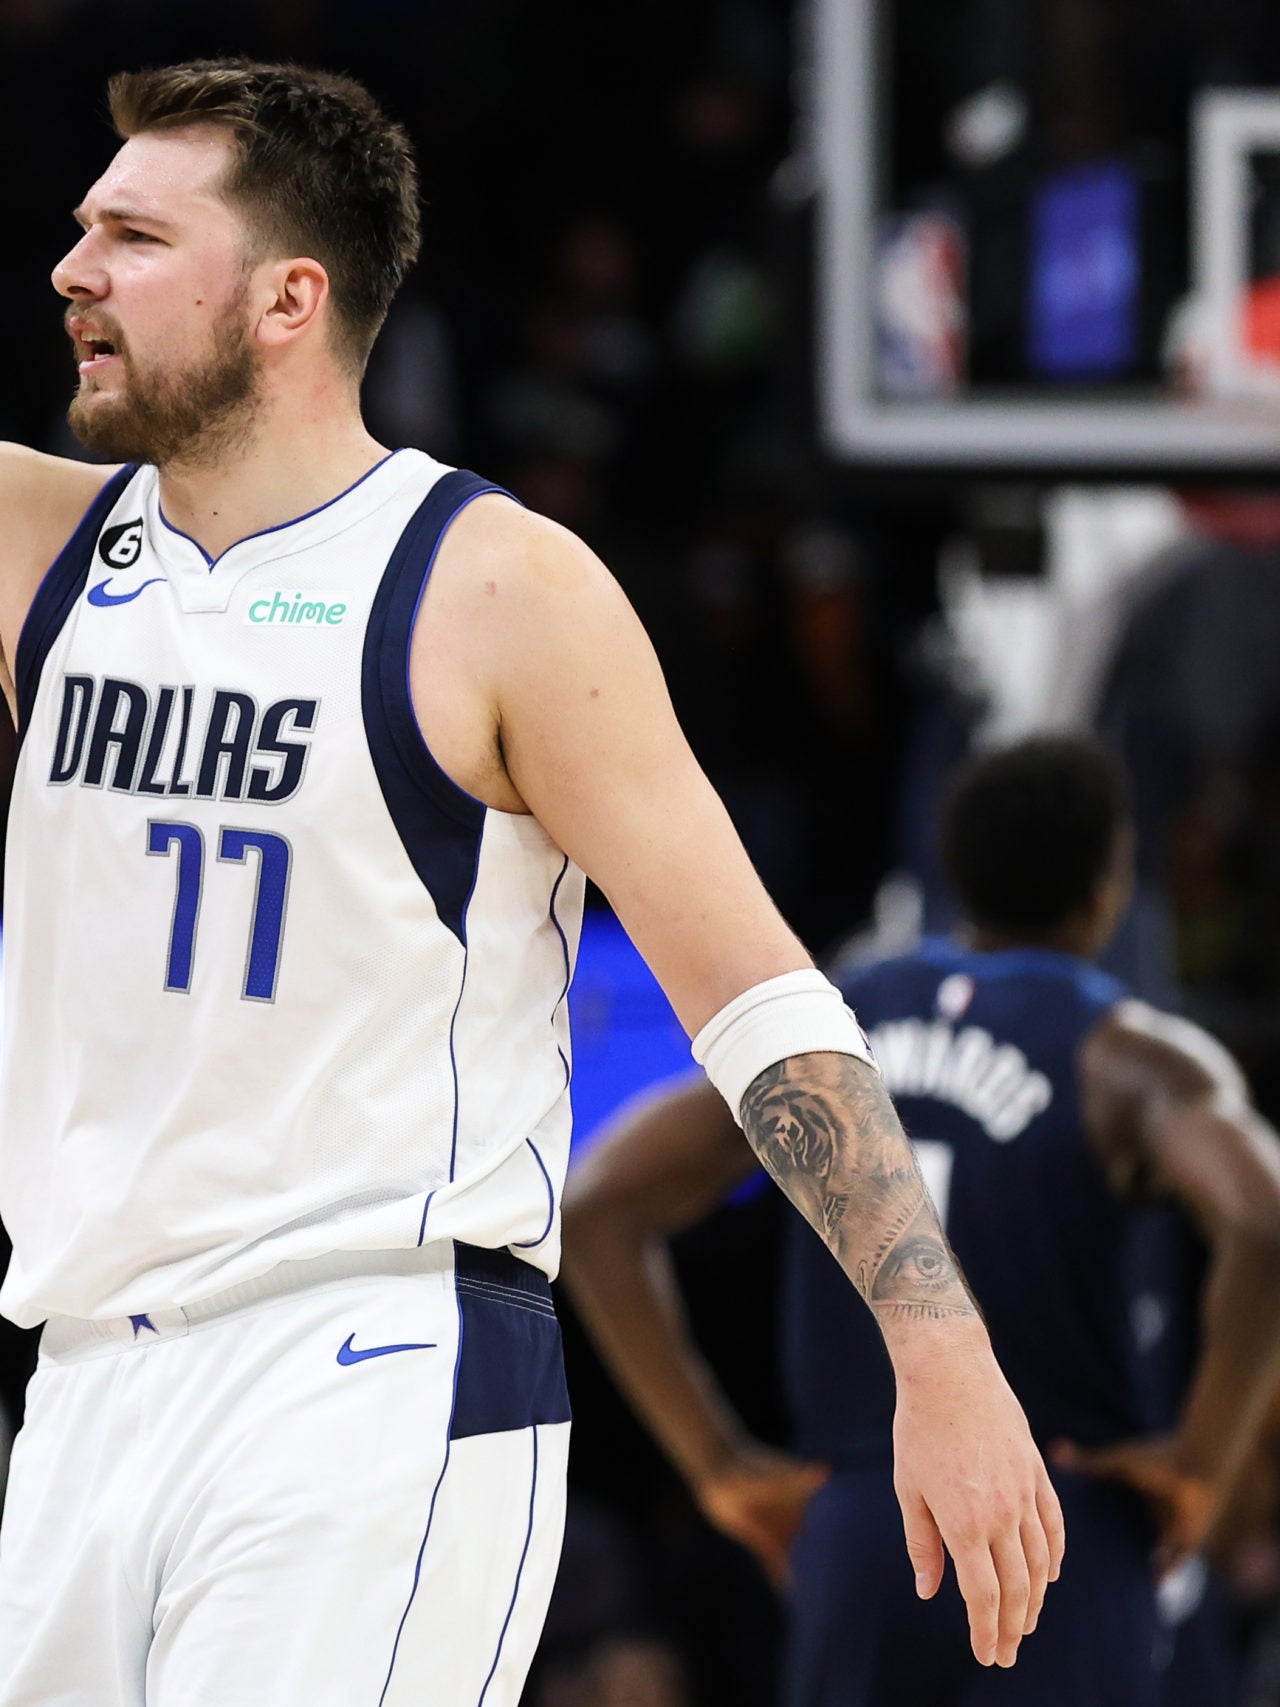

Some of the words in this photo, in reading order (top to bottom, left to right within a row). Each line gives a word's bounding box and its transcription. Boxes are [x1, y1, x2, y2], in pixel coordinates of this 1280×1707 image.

[107, 524, 142, 565] 6
[248, 591, 347, 625] chime
[47, 673, 322, 806] DALLAS
[145, 818, 294, 1004] 77
